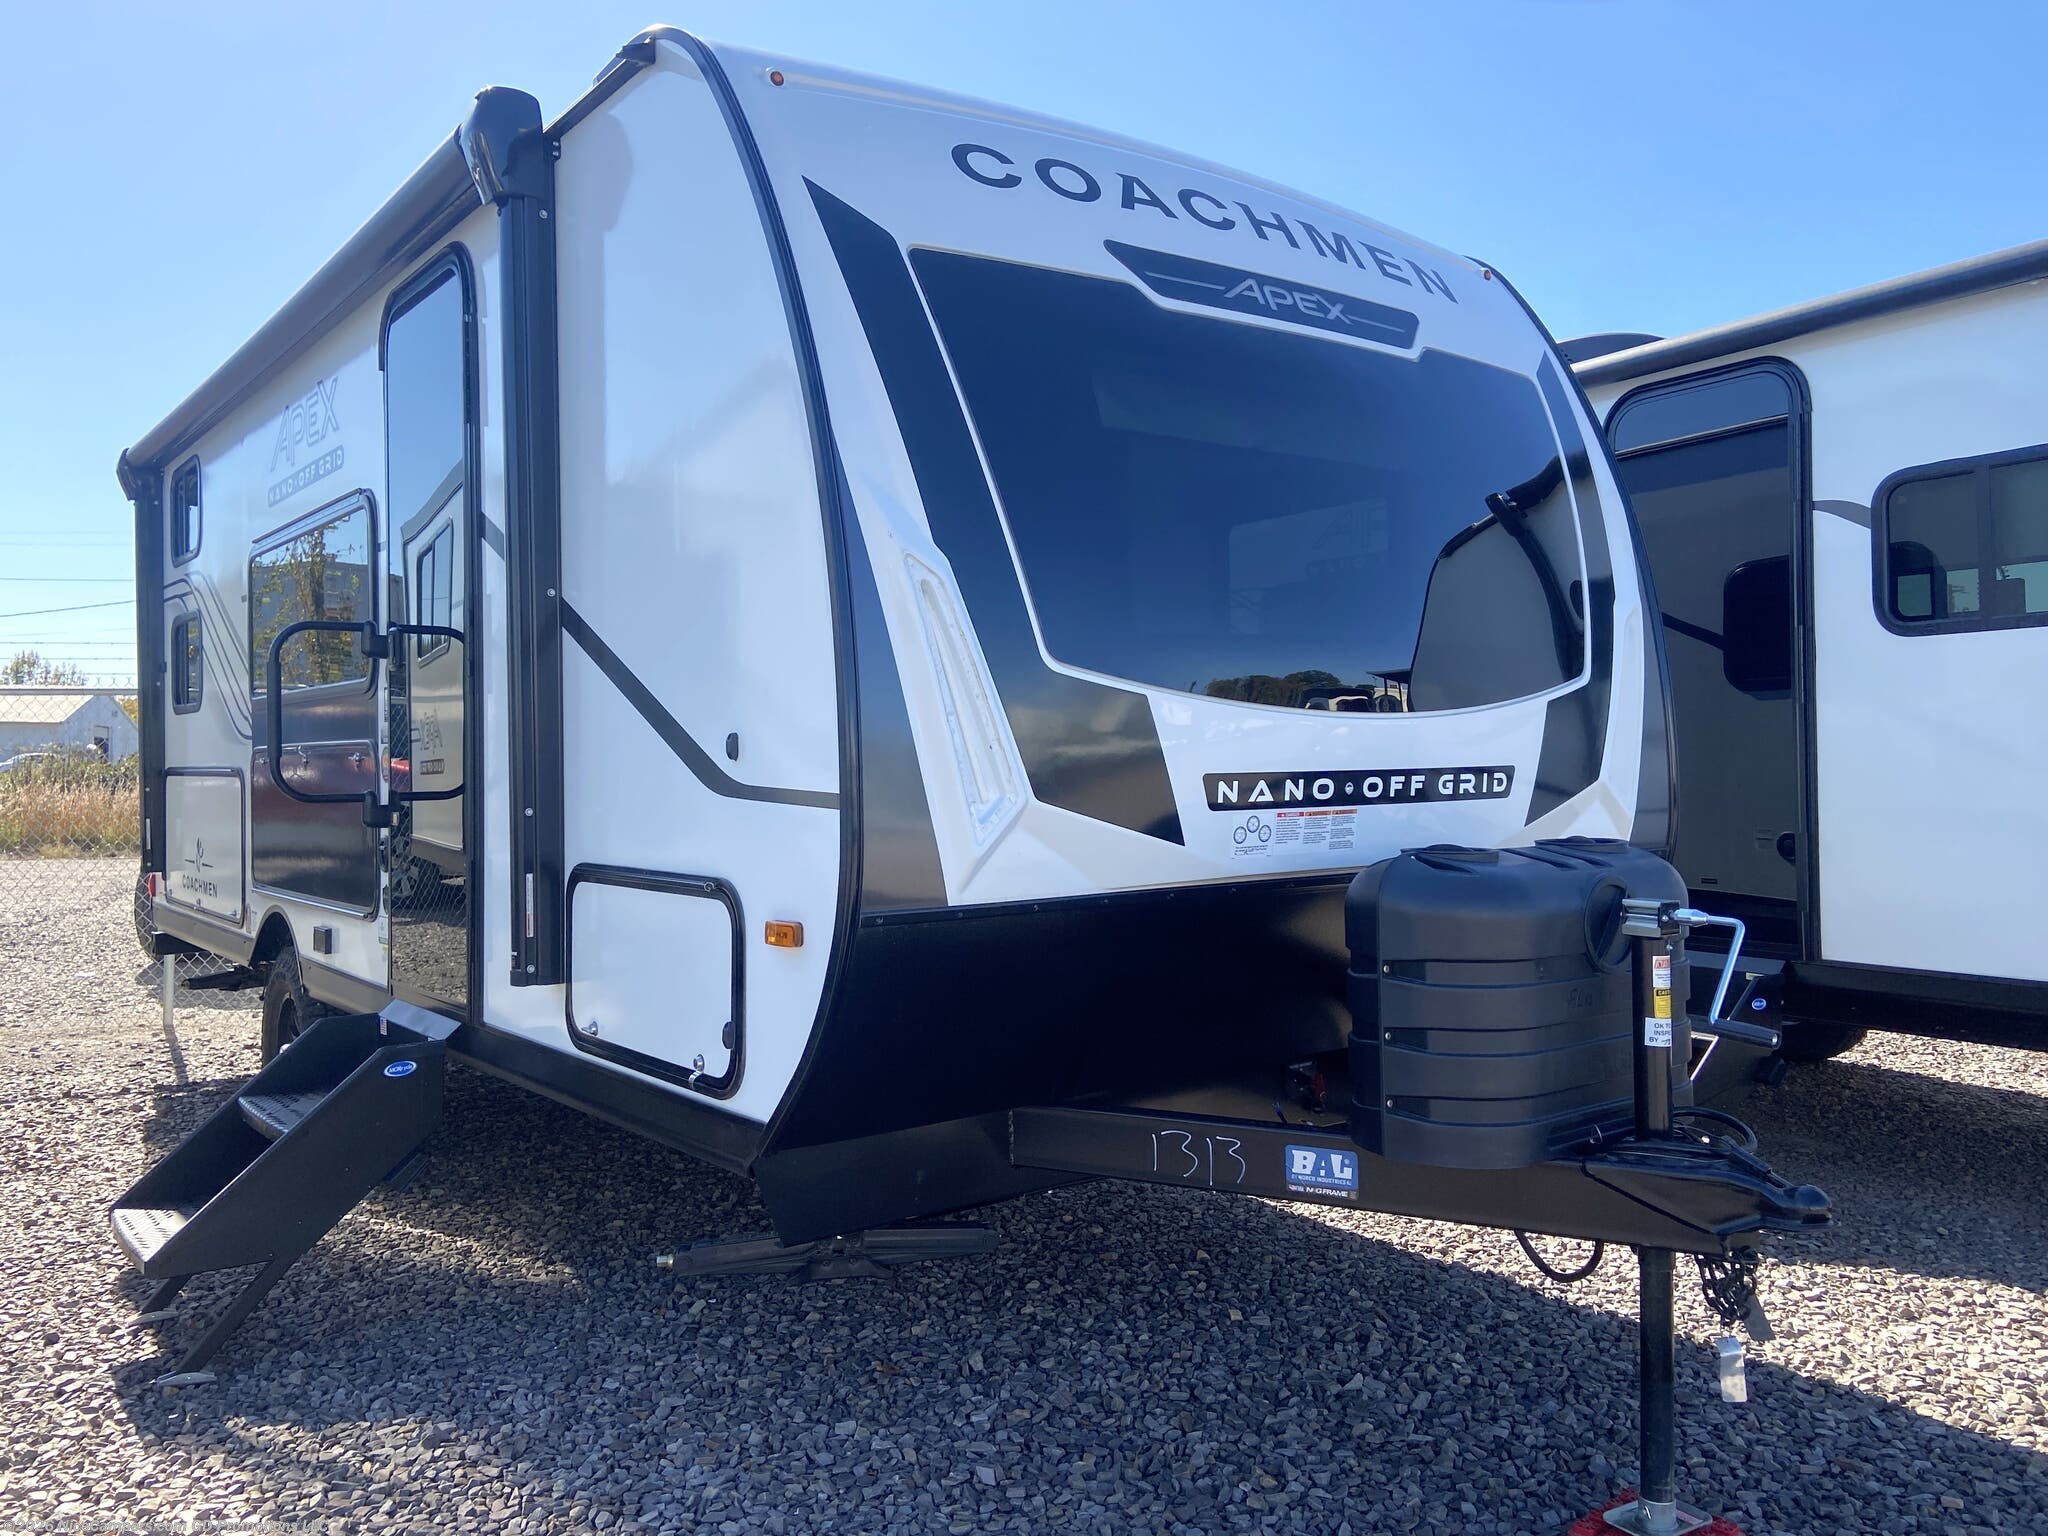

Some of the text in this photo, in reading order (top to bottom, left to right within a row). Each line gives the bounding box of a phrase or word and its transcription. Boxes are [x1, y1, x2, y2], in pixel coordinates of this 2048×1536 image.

[950, 142, 1459, 304] COACHMEN
[1223, 278, 1352, 325] APEX
[270, 376, 340, 473] APEX
[298, 463, 316, 487] OFF
[319, 448, 343, 476] GRID
[1217, 771, 1508, 804] NANO OFF GRID
[182, 874, 218, 898] COACHMEN
[1151, 1129, 1246, 1187] 1313
